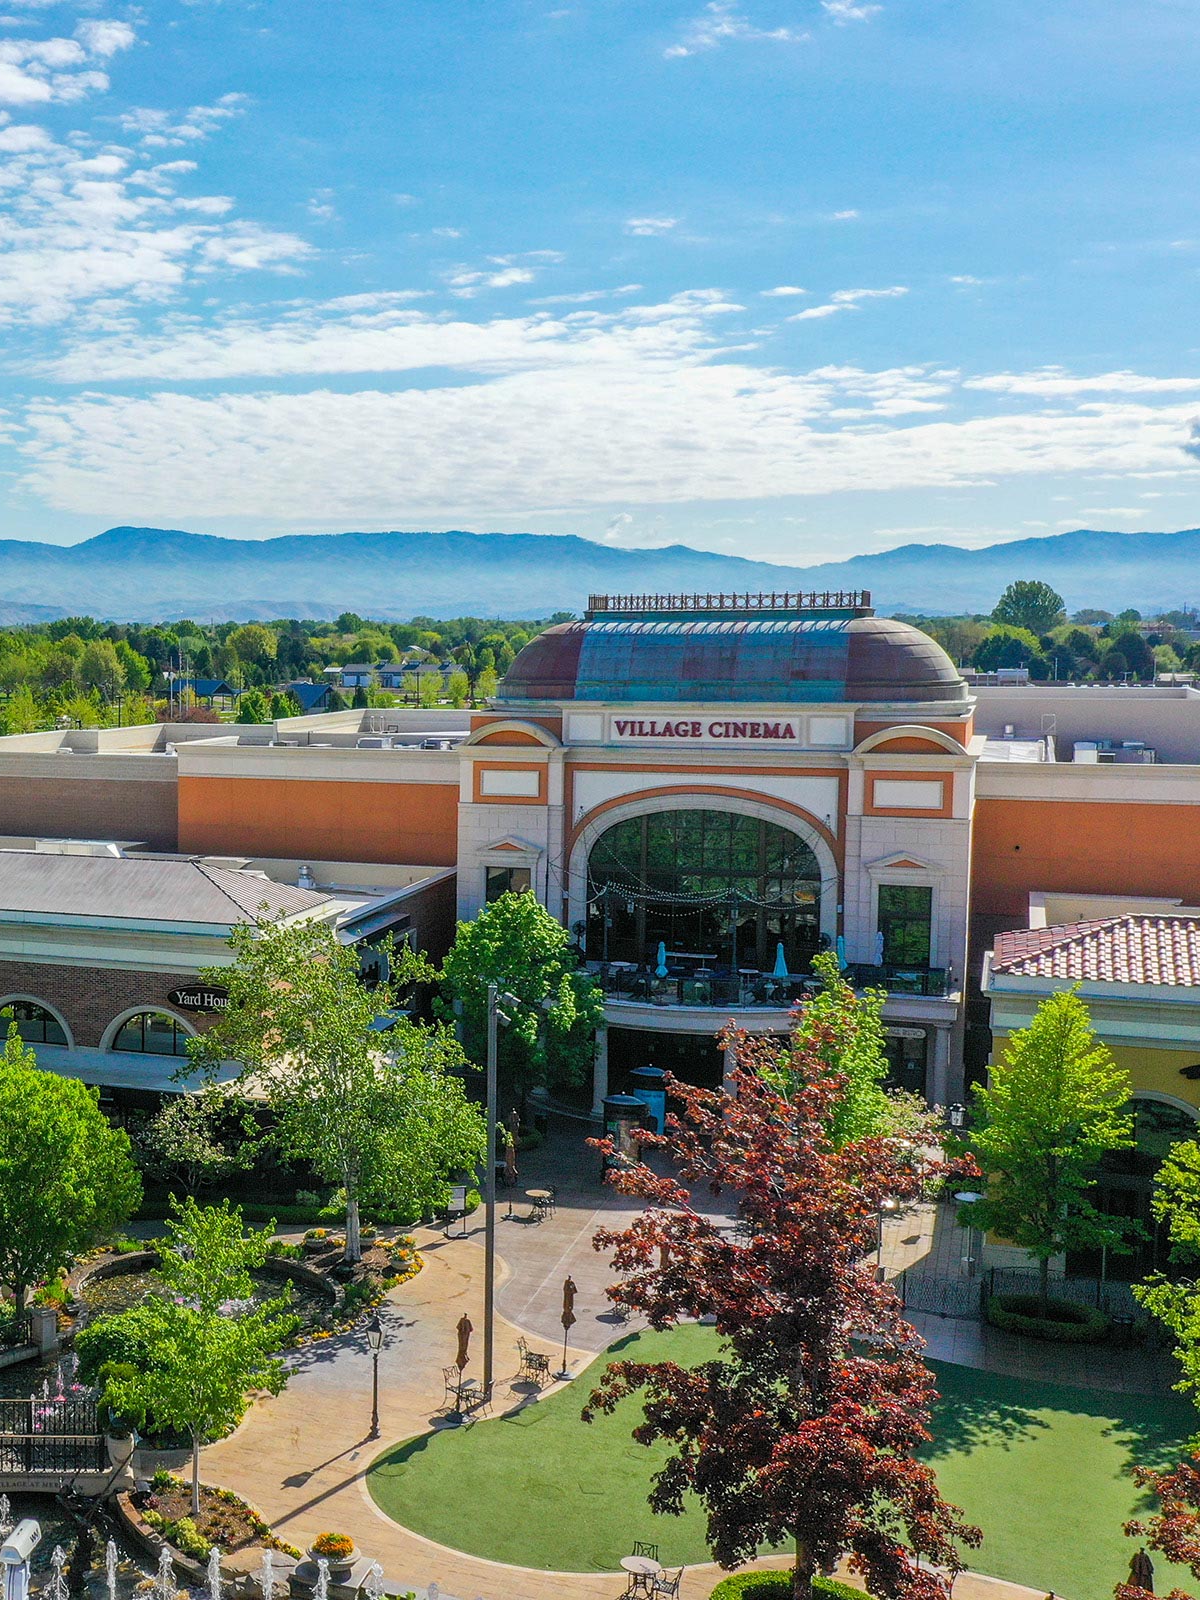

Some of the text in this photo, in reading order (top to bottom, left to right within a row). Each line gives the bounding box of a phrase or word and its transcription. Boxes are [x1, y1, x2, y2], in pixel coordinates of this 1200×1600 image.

[614, 720, 796, 739] VILLAGE CINEMA
[176, 991, 231, 1007] Yard Hou
